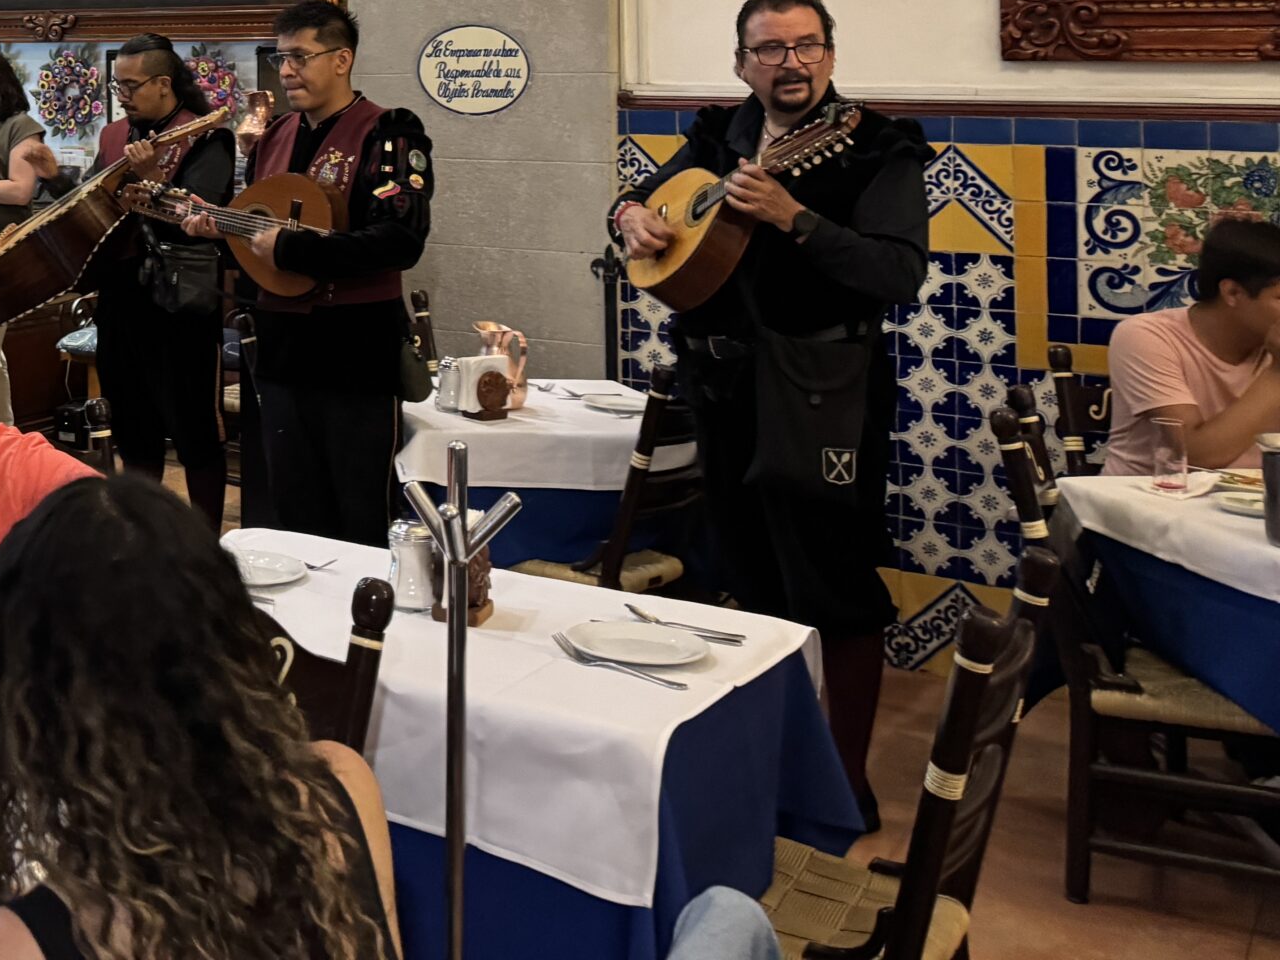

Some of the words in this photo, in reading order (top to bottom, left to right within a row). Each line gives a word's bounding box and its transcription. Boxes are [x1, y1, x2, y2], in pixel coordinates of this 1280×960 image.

[425, 40, 441, 58] La
[443, 40, 482, 64] Empresa
[435, 60, 493, 84] Responsable
[492, 59, 502, 78] de
[470, 80, 516, 98] Personales
